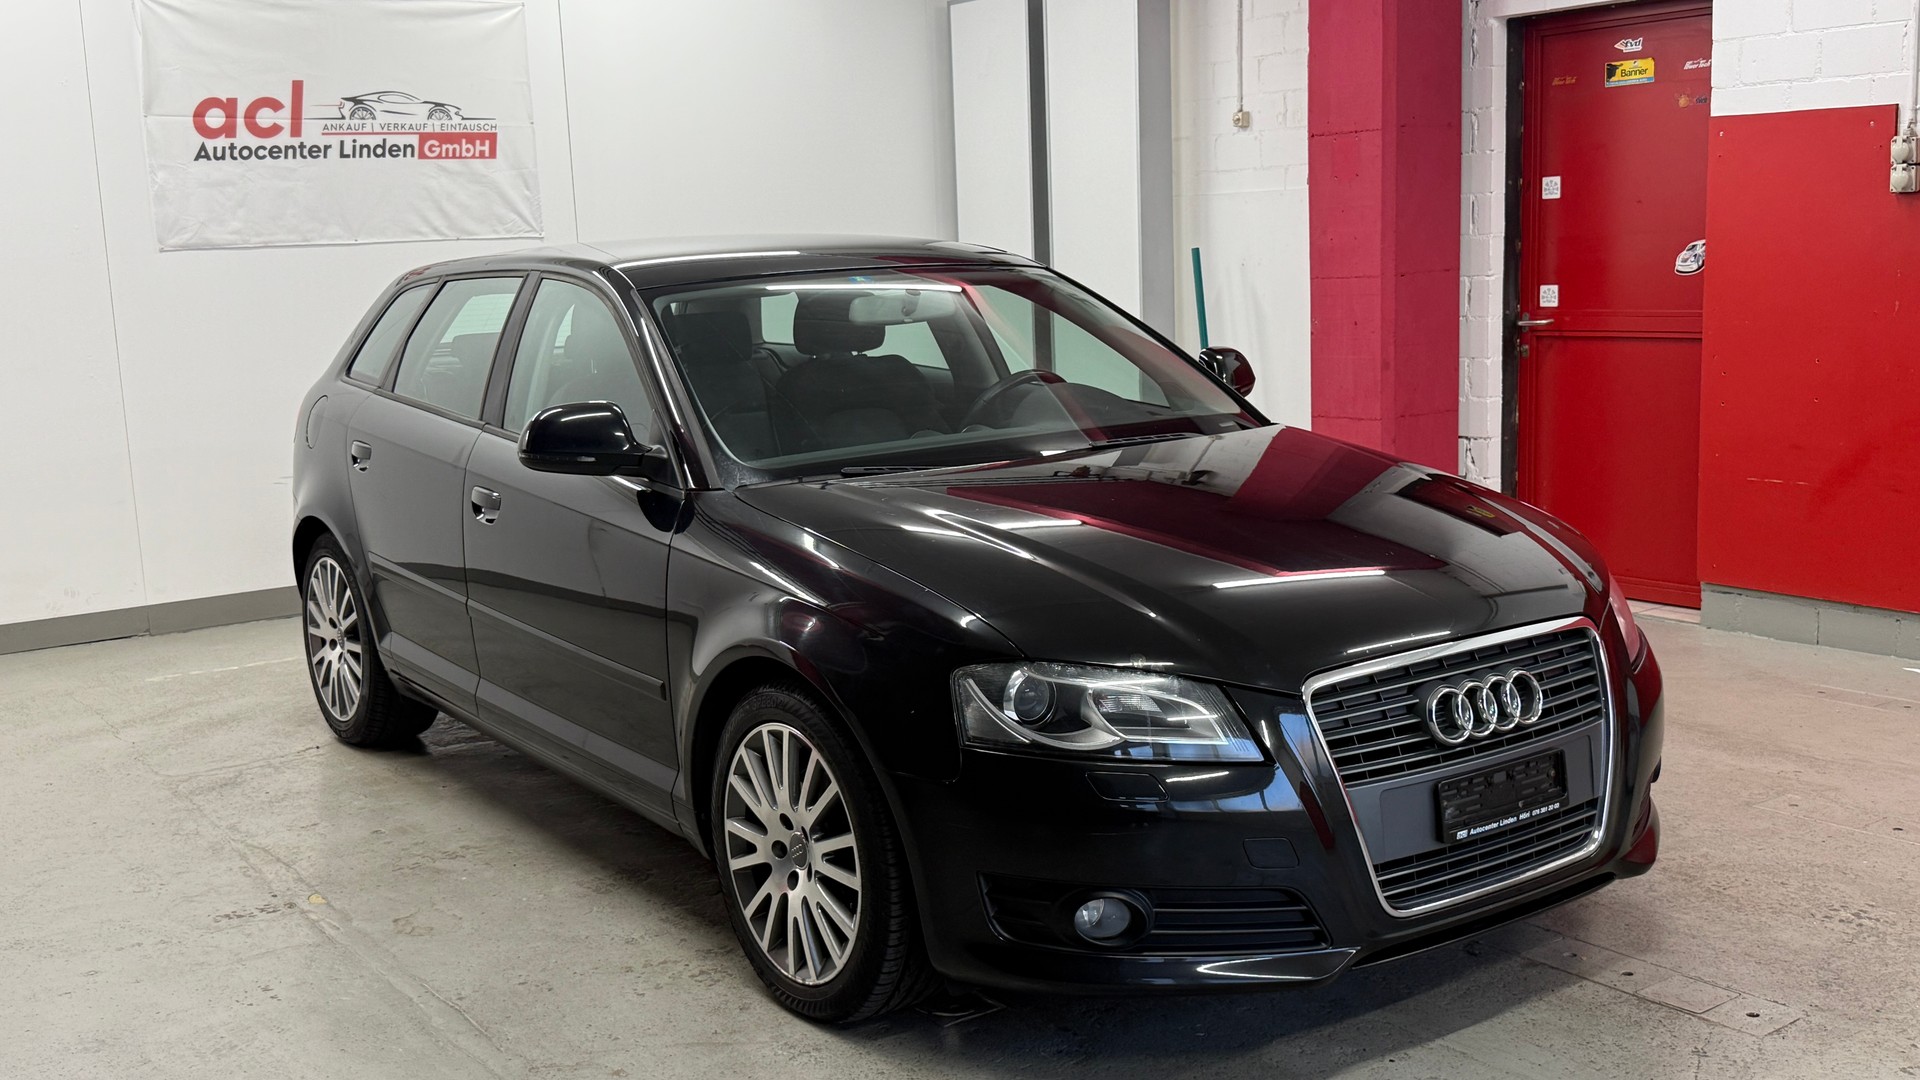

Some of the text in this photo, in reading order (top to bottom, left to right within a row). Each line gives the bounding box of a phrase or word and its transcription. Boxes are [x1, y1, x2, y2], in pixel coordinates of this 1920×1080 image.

[1620, 67, 1649, 78] Banner
[192, 80, 304, 139] acl
[322, 122, 497, 132] ANKAUF VERKAUF EINTAUSCH
[193, 138, 490, 162] Autocenter Linden GmbH
[1469, 822, 1499, 835] Autocenter
[1500, 816, 1517, 826] Linden
